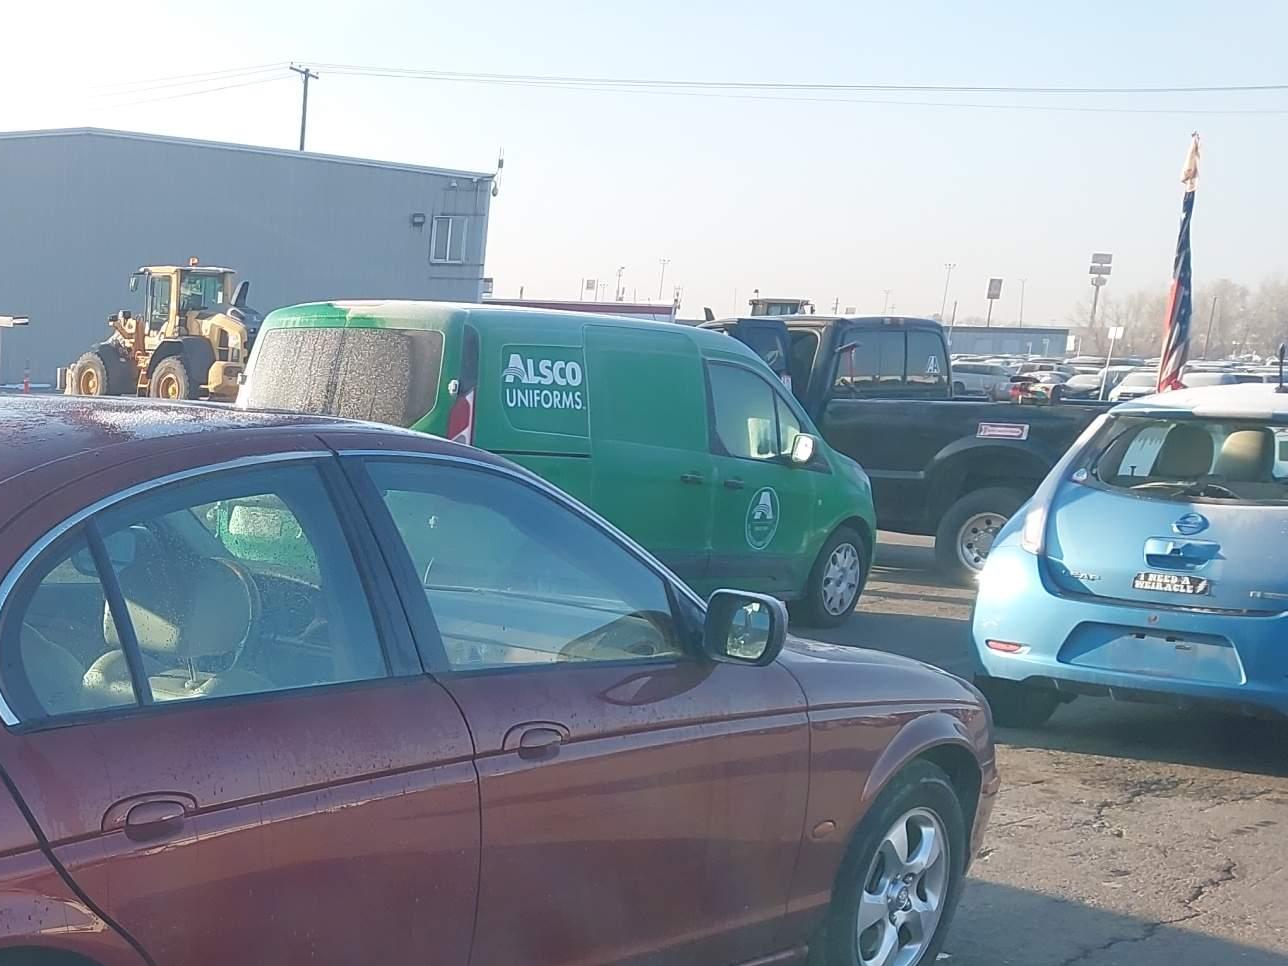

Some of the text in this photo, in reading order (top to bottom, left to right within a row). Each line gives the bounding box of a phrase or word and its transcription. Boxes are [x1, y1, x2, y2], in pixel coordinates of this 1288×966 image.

[501, 353, 582, 387] ALSCO
[505, 388, 583, 410] UNIFORMS
[1182, 576, 1191, 585] A
